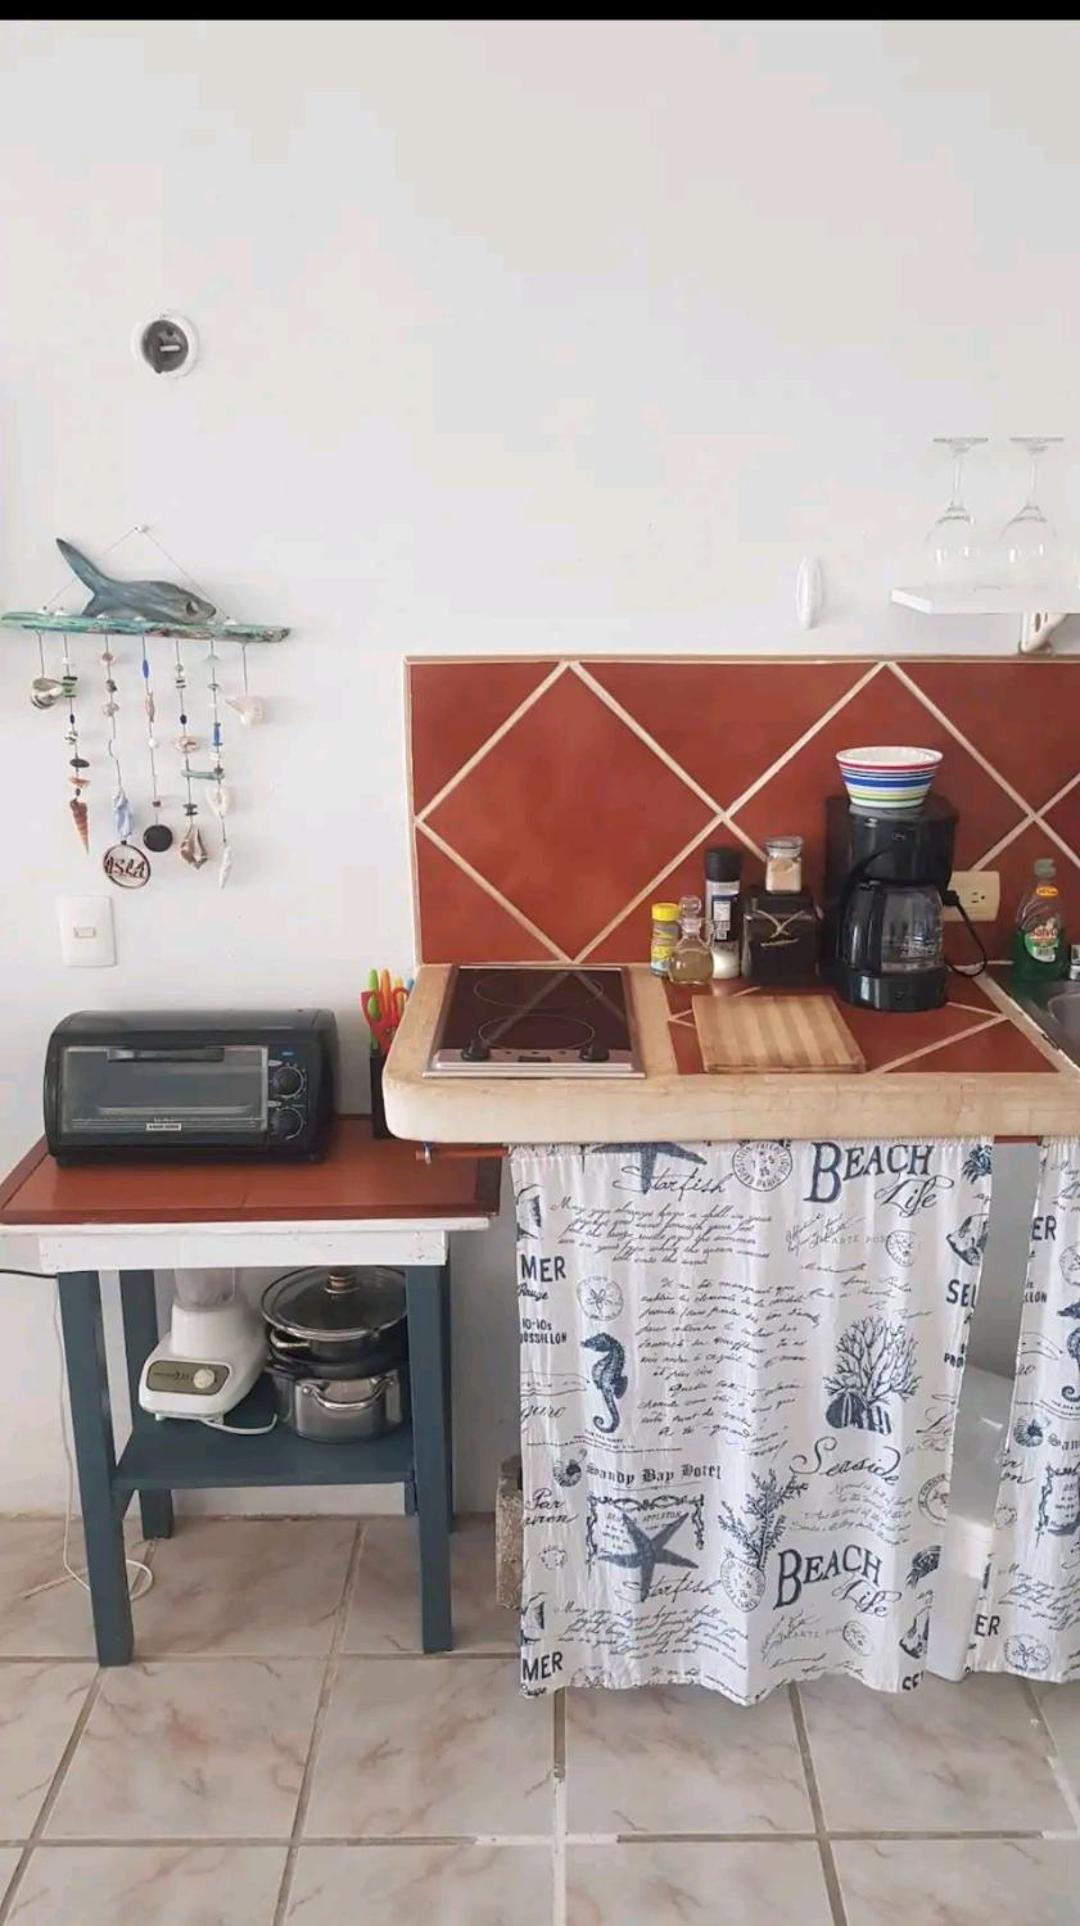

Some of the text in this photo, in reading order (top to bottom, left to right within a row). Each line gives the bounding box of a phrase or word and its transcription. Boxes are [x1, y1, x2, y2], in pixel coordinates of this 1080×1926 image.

[803, 1142, 935, 1203] BEACH
[874, 1175, 955, 1217] Life
[1031, 1215, 1057, 1240] ER
[521, 1254, 566, 1282] MER
[586, 1462, 721, 1488] Sandy Bay Hotel
[789, 1436, 901, 1485] Seaside
[773, 1544, 882, 1610] BEACH
[831, 1578, 902, 1617] Life
[974, 1614, 1000, 1637] ER
[522, 1651, 563, 1682] MER
